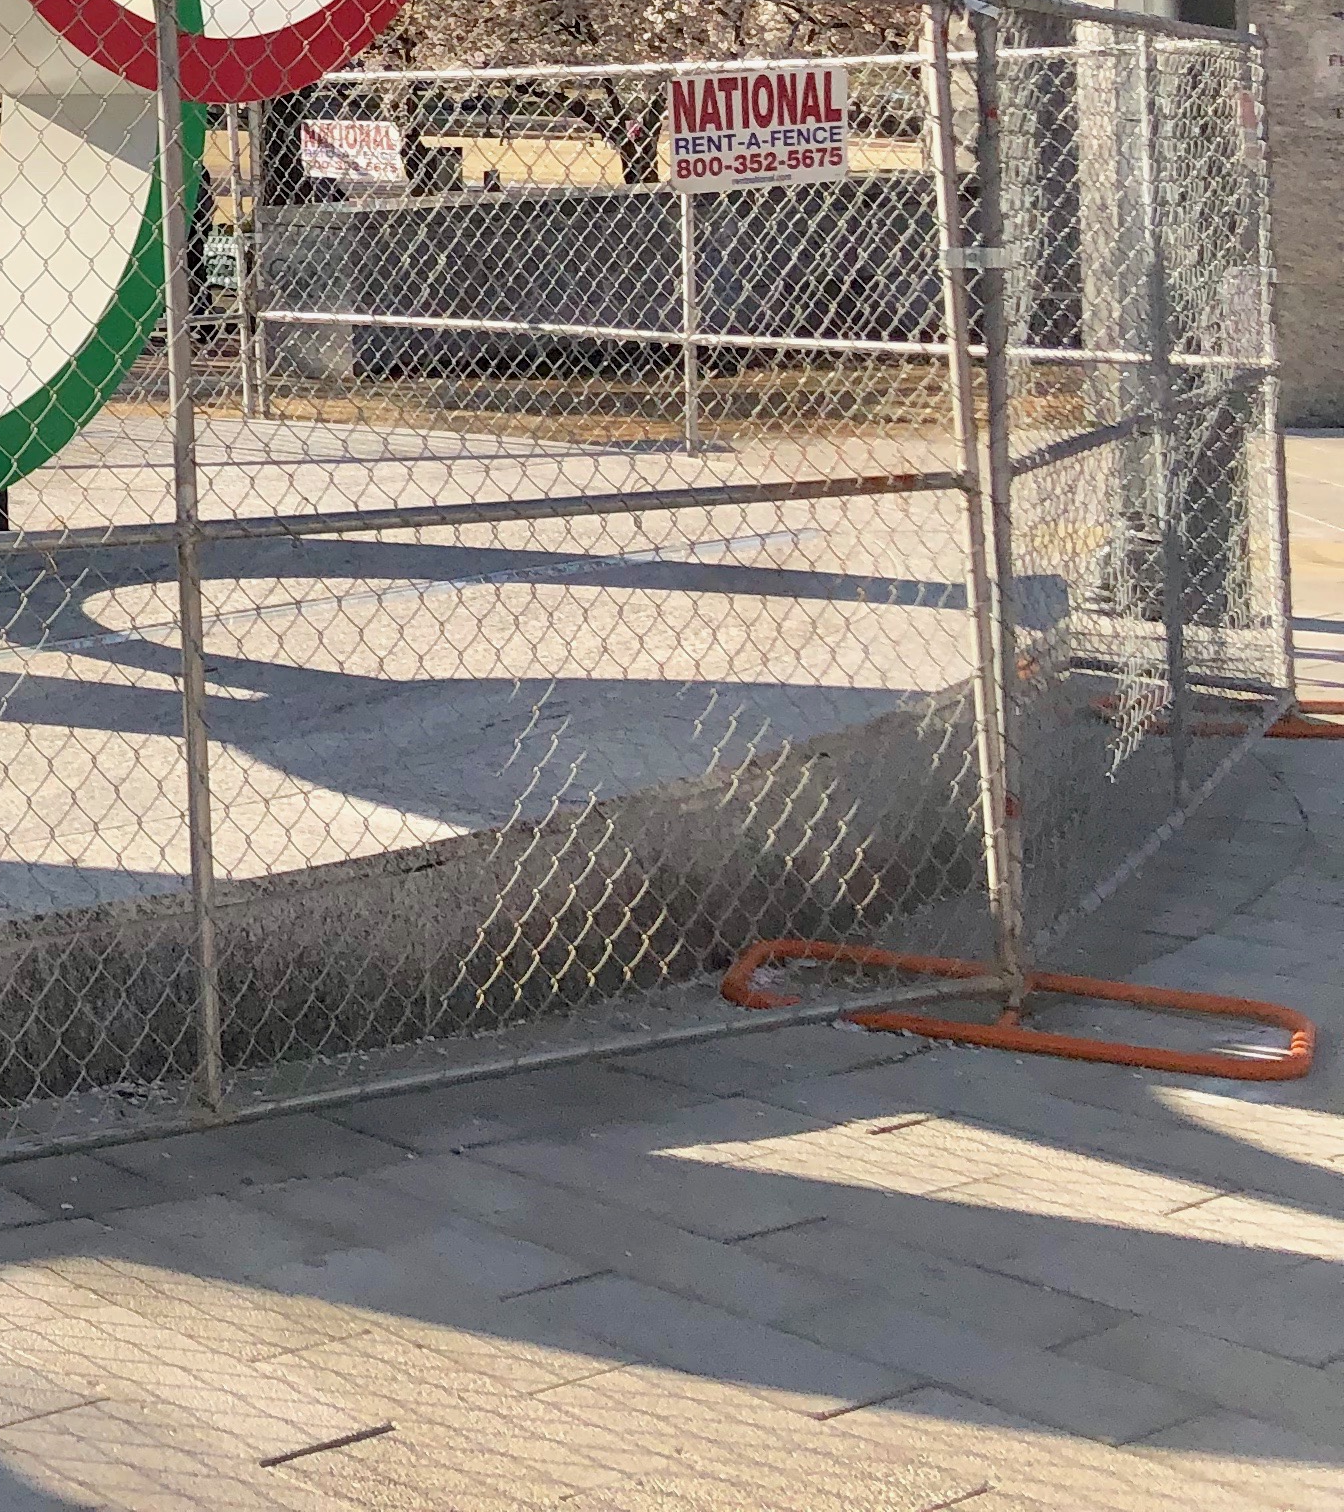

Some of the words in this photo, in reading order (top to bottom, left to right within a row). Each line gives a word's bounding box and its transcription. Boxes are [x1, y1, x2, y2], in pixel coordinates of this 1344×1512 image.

[672, 71, 842, 135] NATIONAL
[674, 125, 843, 156] RENT-A-FENCE
[676, 147, 843, 179] 800-352-5675
